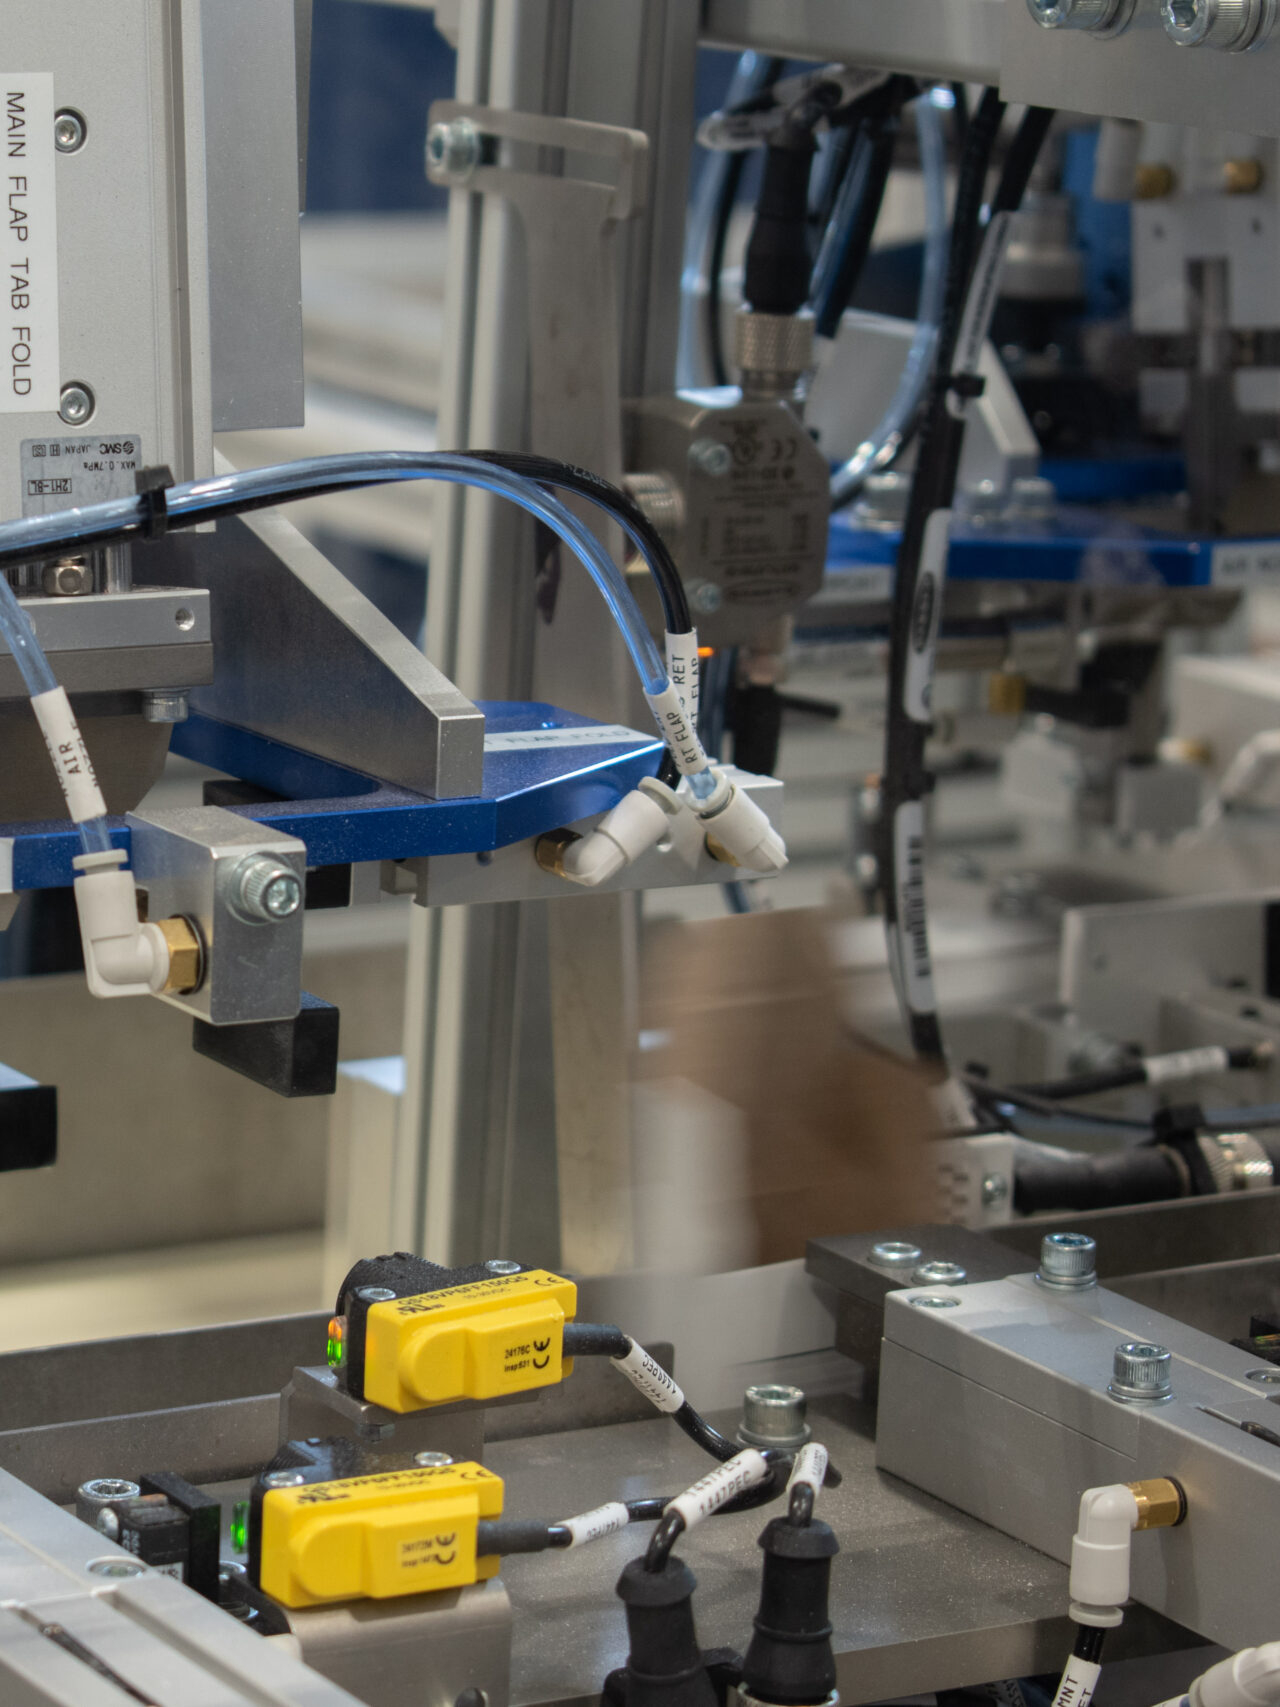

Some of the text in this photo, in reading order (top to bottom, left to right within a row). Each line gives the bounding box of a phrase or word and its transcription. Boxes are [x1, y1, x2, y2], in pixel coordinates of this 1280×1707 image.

[6, 92, 32, 396] MAIN FLAP TAB FOLD
[65, 444, 91, 454] JAPAN
[99, 442, 122, 455] SMC
[672, 654, 686, 685] RET
[666, 711, 689, 743] FLAP
[58, 742, 81, 776] AIR
[681, 746, 698, 764] RT
